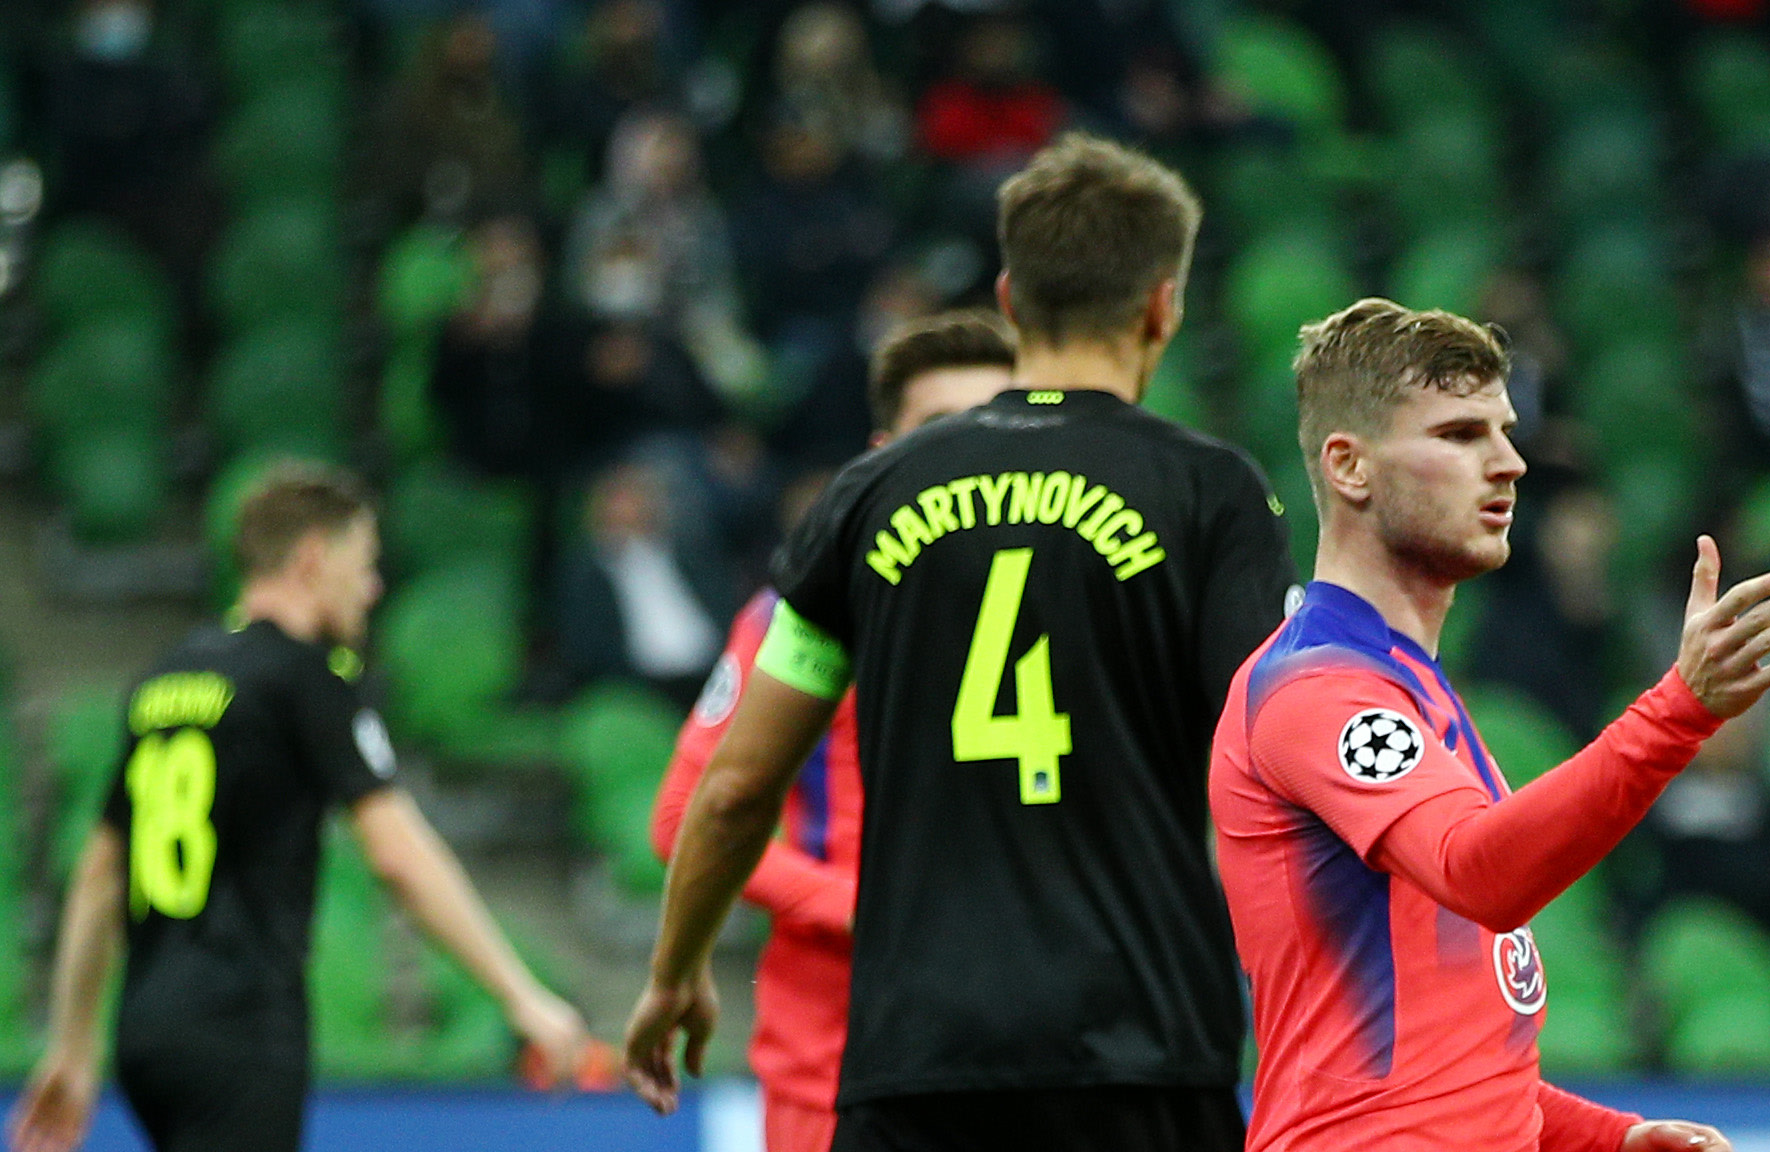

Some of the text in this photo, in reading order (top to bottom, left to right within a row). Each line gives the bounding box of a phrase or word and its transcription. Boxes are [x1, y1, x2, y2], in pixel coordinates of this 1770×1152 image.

[865, 470, 1166, 586] MARTYNOVICH
[951, 547, 1072, 805] 4
[124, 726, 217, 923] 18
